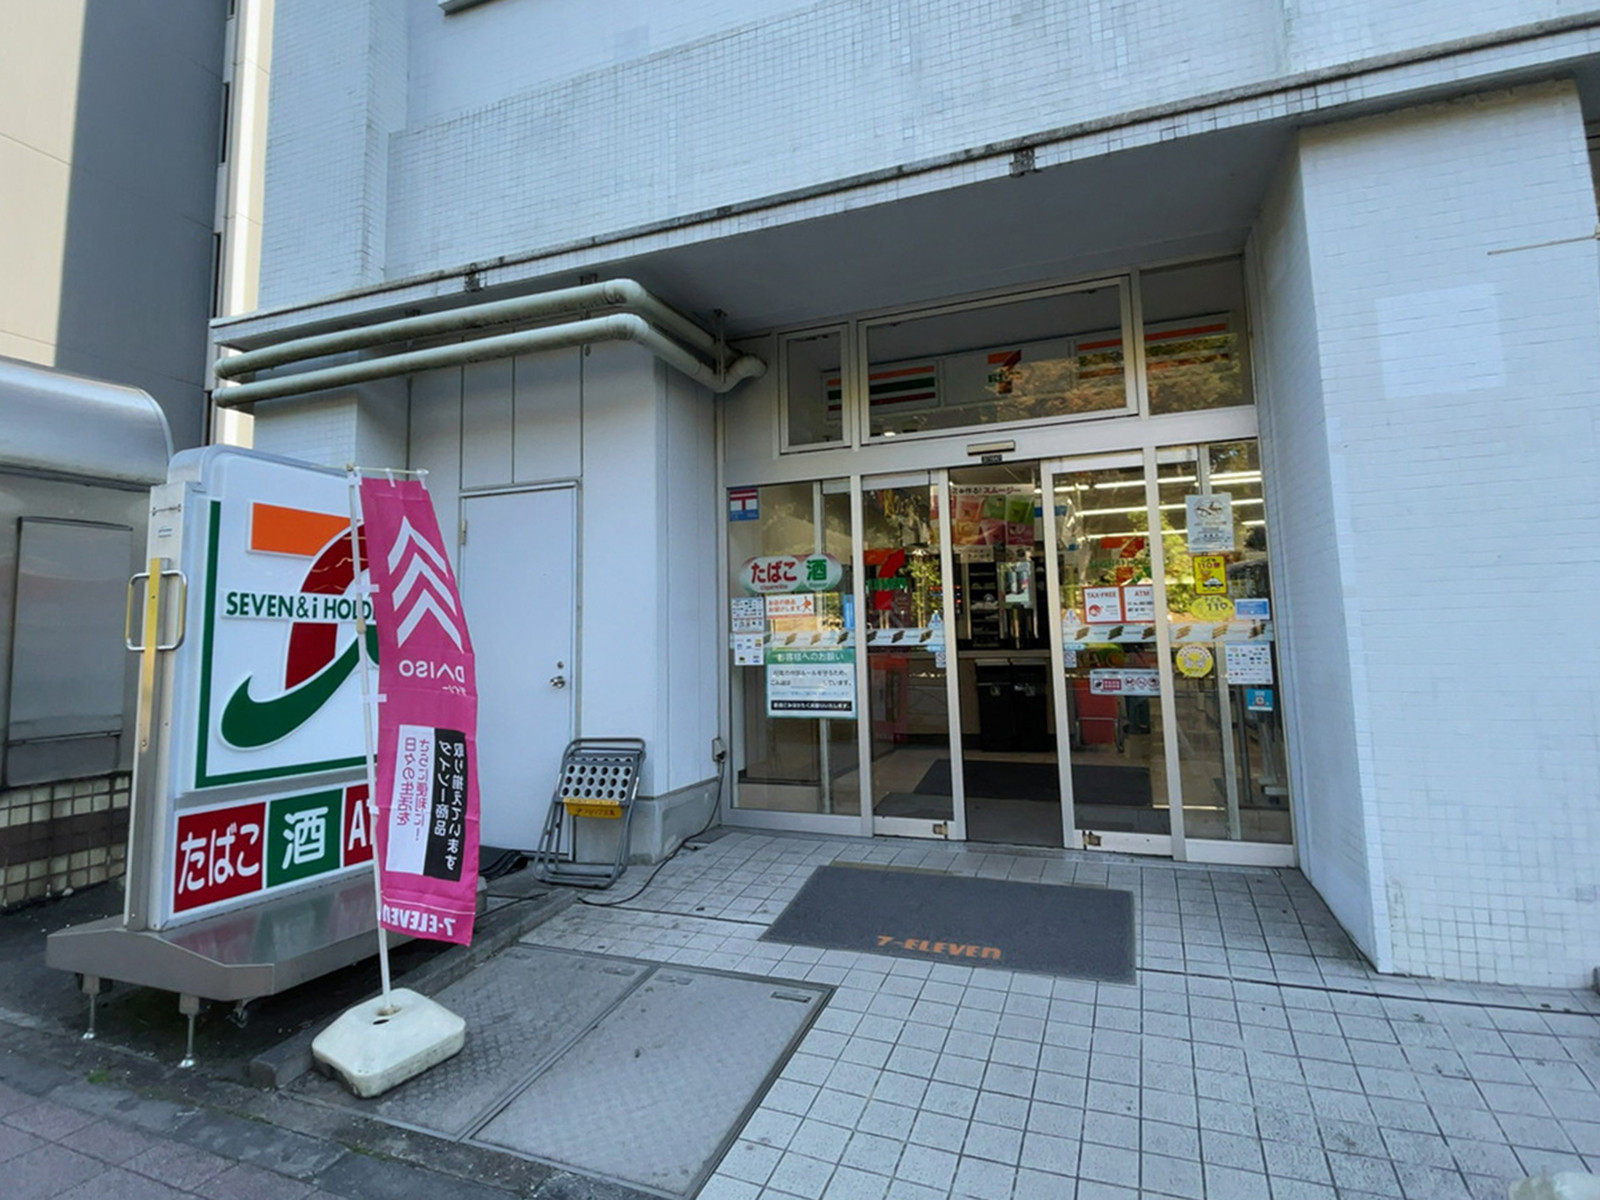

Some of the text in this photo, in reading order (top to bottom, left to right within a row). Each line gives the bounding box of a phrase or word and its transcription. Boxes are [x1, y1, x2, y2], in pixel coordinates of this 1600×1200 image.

[751, 558, 828, 584] たばこ 酒
[324, 597, 376, 618] HOLD
[177, 822, 260, 895] たばこ
[282, 806, 330, 870] 酒
